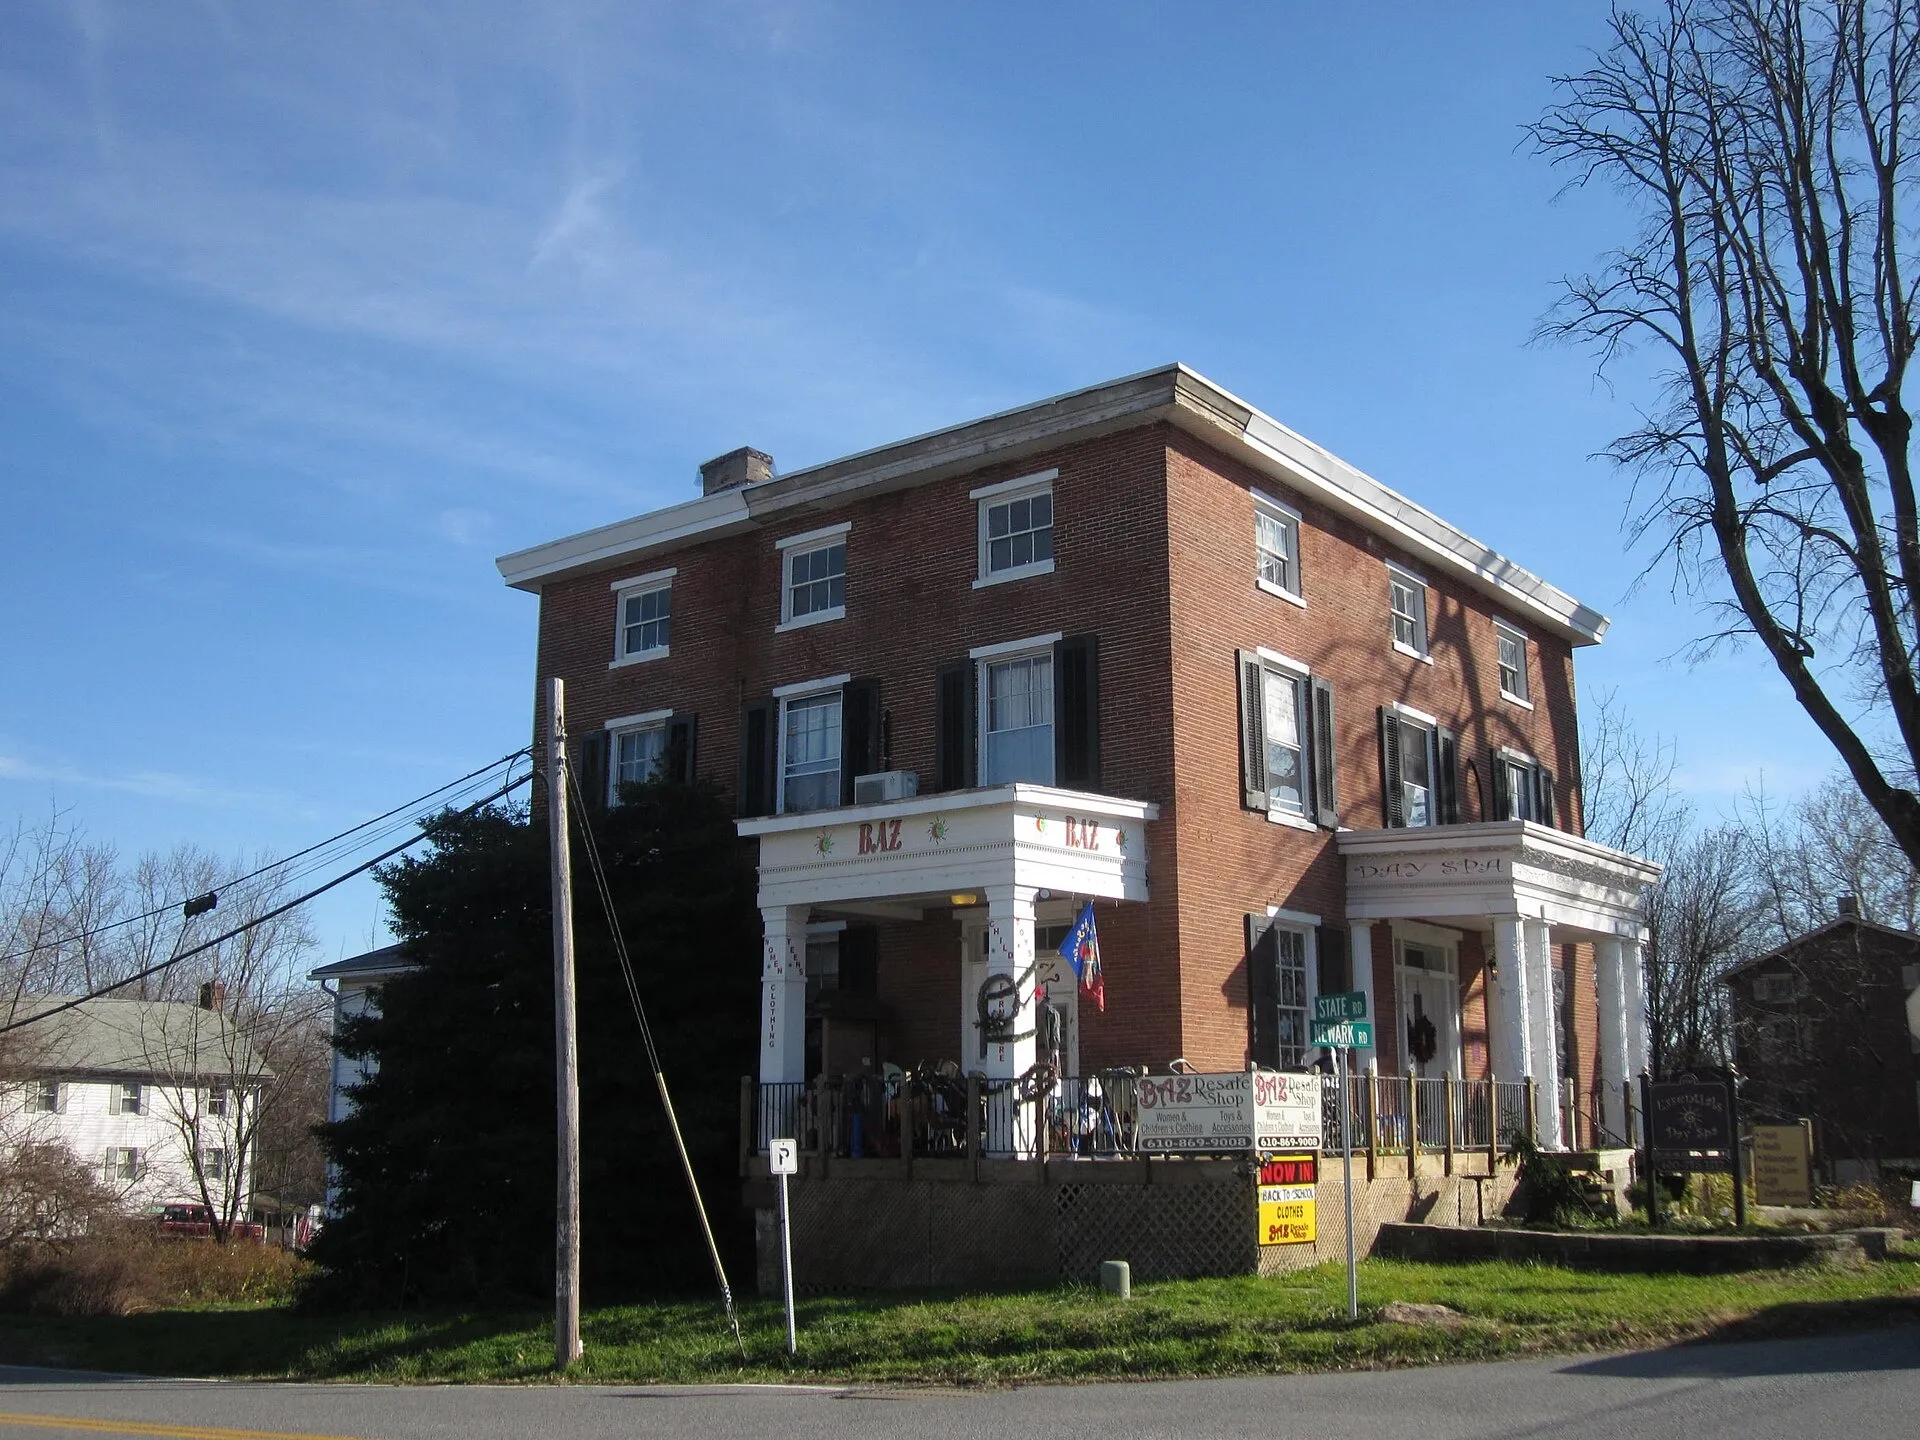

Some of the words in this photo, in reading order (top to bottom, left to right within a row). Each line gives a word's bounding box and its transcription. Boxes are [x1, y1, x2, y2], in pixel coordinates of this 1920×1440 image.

[858, 819, 902, 855] BAZ
[1065, 815, 1099, 851] BAZ
[1354, 862, 1428, 879] DAY
[1441, 858, 1504, 875] SPA
[989, 920, 1013, 959] CHILD
[765, 938, 783, 975] WOMEN
[786, 938, 804, 975] TEENS
[769, 984, 777, 1048] CLOTHING
[1319, 997, 1347, 1018] STATE
[1352, 1001, 1362, 1014] RD
[1314, 1023, 1355, 1044] NEWARK
[1358, 1031, 1368, 1044] RD
[1140, 1078, 1192, 1109] BAZ
[1195, 1076, 1250, 1098] Resale
[1207, 1092, 1244, 1107] Shop
[1255, 1075, 1288, 1106] BAZ
[1289, 1076, 1320, 1098] Resale
[1296, 1092, 1316, 1109] Shop
[1156, 1112, 1180, 1122] Women
[1181, 1111, 1187, 1121] &
[1219, 1111, 1235, 1122] Toys
[1237, 1110, 1243, 1120] &
[1176, 1123, 1203, 1133] Clothing
[1212, 1123, 1251, 1133] Accessories
[1147, 1138, 1246, 1148] 610-869-9008
[1261, 1137, 1317, 1147] 610-869-9008
[1262, 1163, 1295, 1183] NOW
[1263, 1190, 1281, 1201] BACK
[1283, 1189, 1290, 1200] TO
[1292, 1188, 1313, 1199] SCHOOL
[1277, 1206, 1303, 1219] CLOTHES
[1269, 1224, 1289, 1241] BAZ
